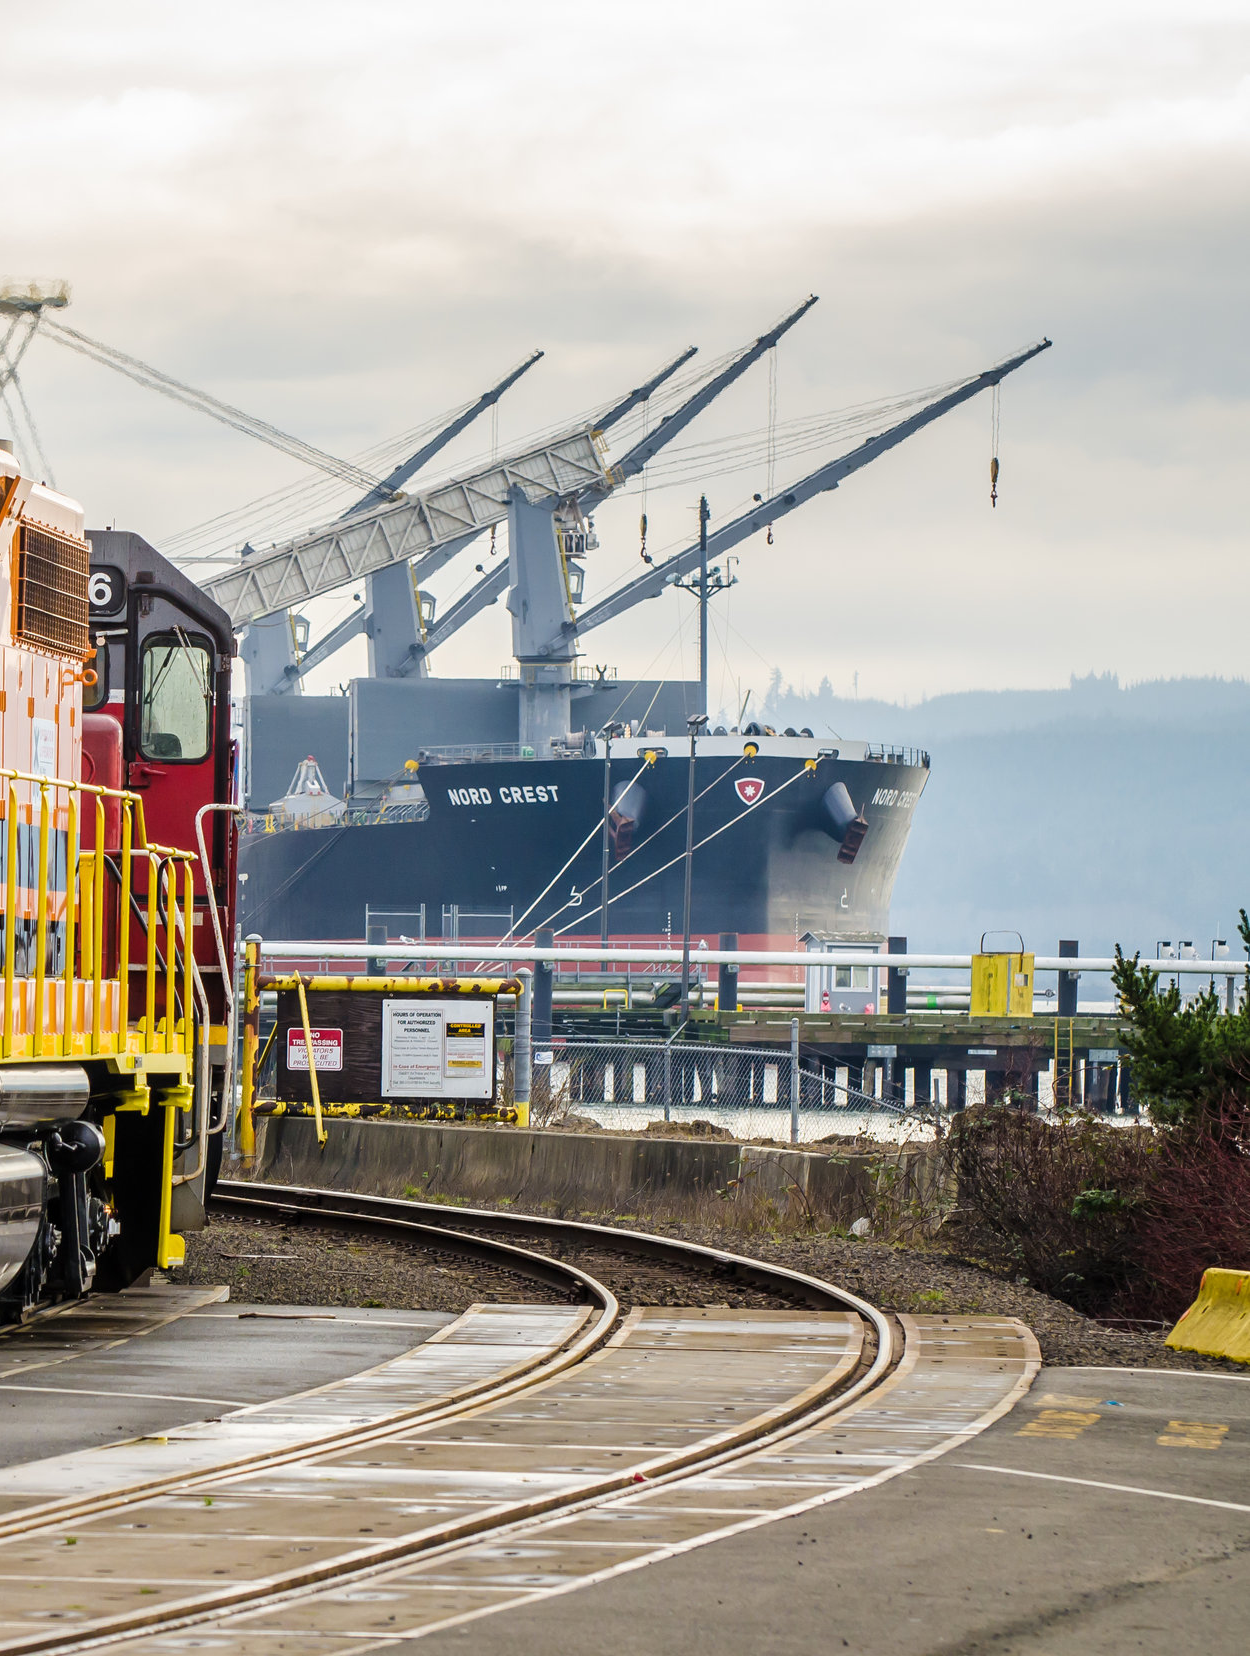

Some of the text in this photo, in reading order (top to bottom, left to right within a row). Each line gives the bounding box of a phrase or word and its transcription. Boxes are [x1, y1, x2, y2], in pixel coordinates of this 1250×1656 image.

[88, 572, 113, 606] 6
[447, 785, 559, 806] NORD CREST
[871, 788, 899, 806] NORD
